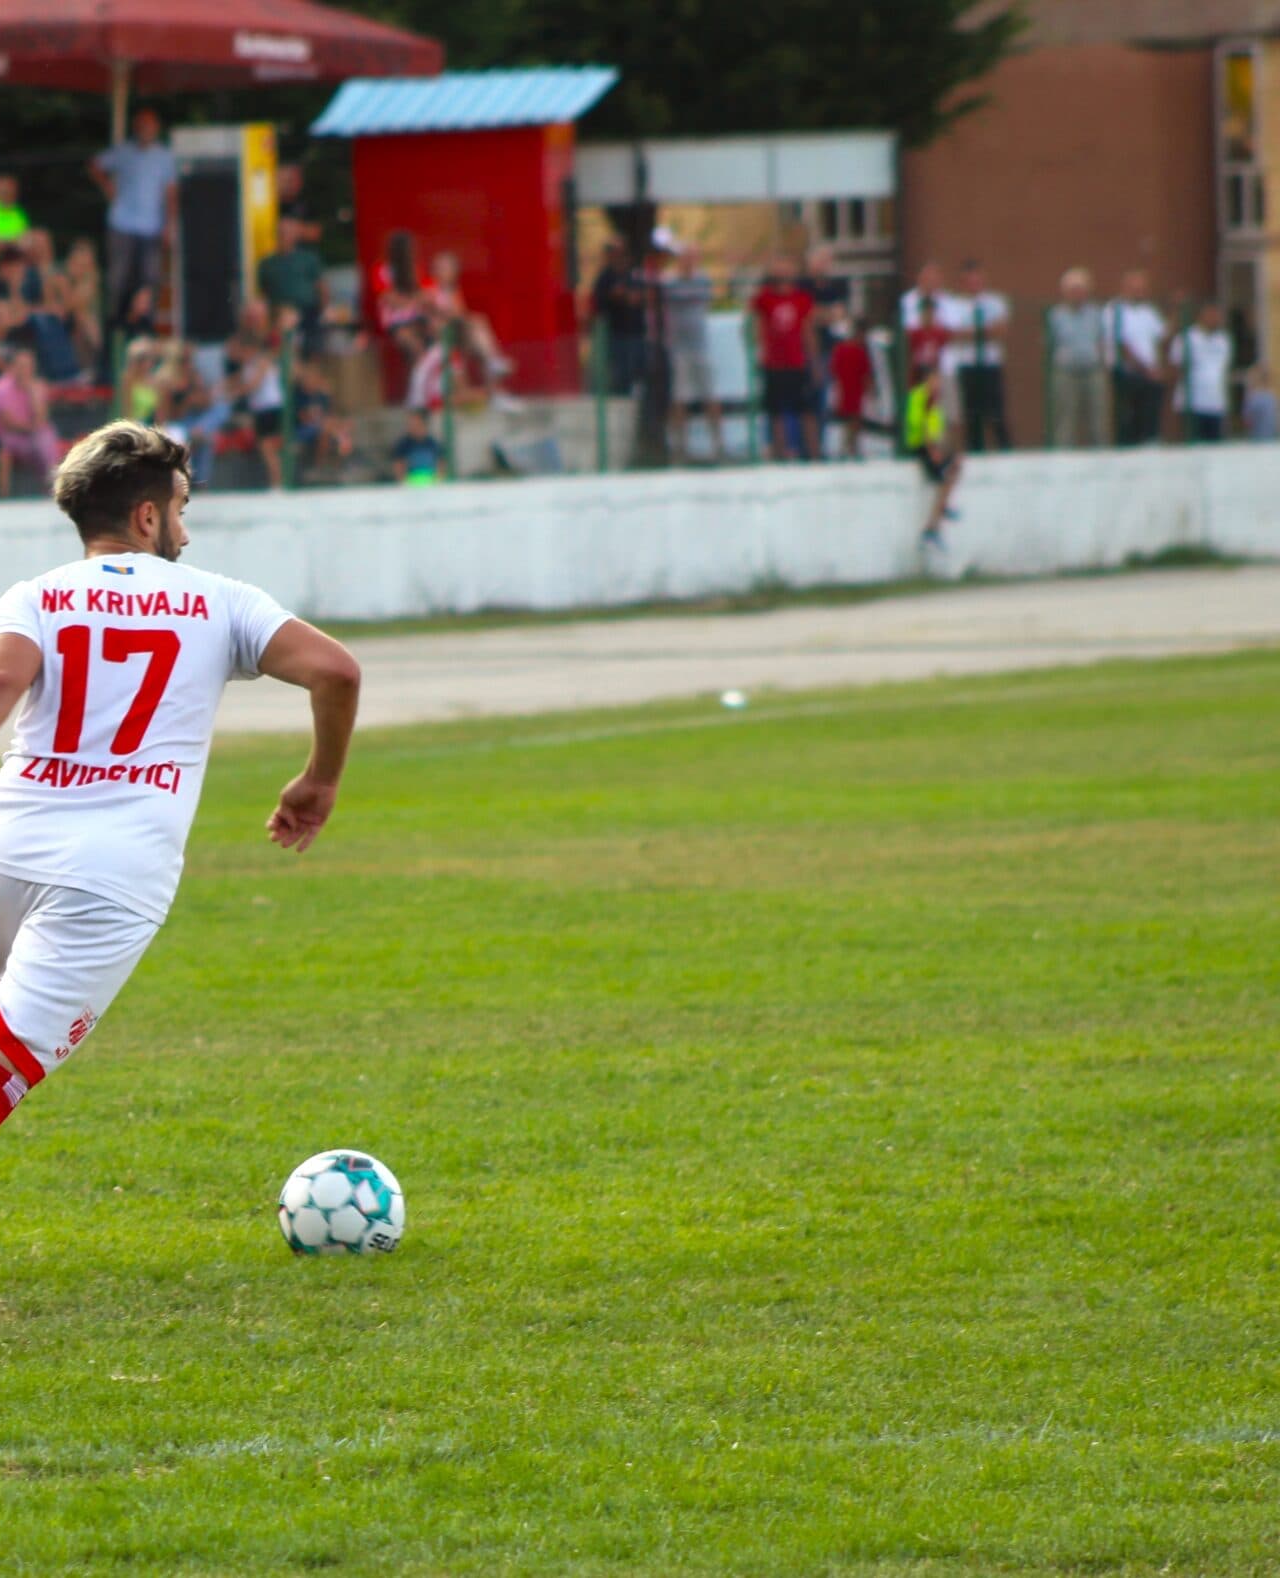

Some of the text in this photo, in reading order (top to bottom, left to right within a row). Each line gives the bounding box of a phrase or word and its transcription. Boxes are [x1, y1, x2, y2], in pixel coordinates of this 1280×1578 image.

[41, 588, 208, 620] NK KRIVAJA
[53, 624, 181, 755] 17
